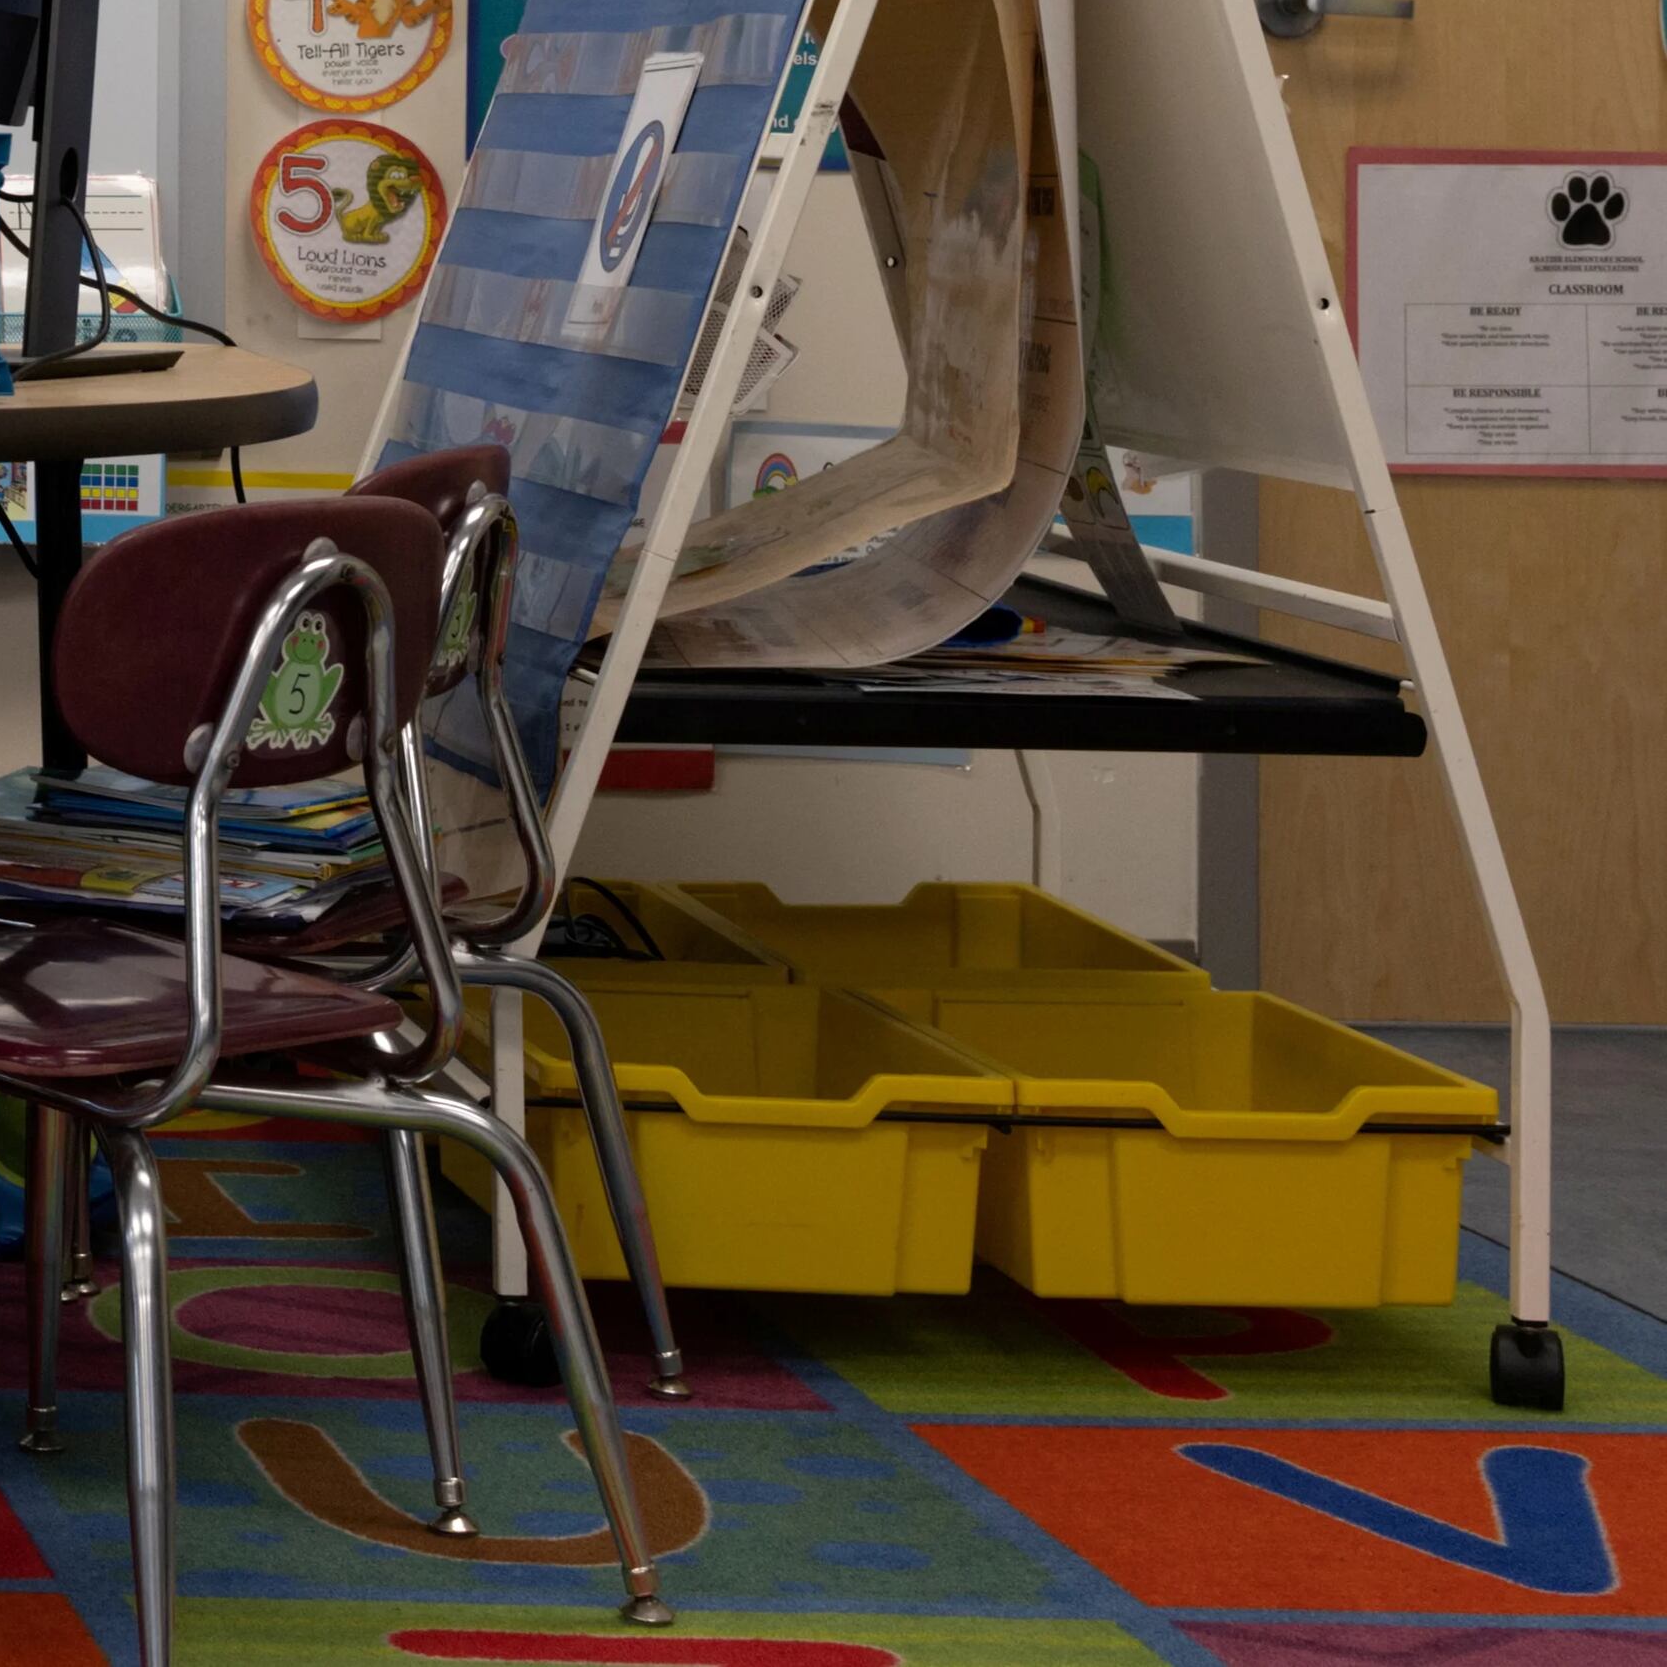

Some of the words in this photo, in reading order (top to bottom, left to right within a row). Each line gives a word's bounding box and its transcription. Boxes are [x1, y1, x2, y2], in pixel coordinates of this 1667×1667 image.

[297, 44, 350, 60] Tell-All
[355, 42, 405, 59] Tigers
[276, 153, 332, 234] 5
[298, 246, 338, 265] Loud
[342, 252, 386, 270] Lions
[1549, 285, 1623, 295] CLASSROOM
[289, 672, 309, 715] 5
